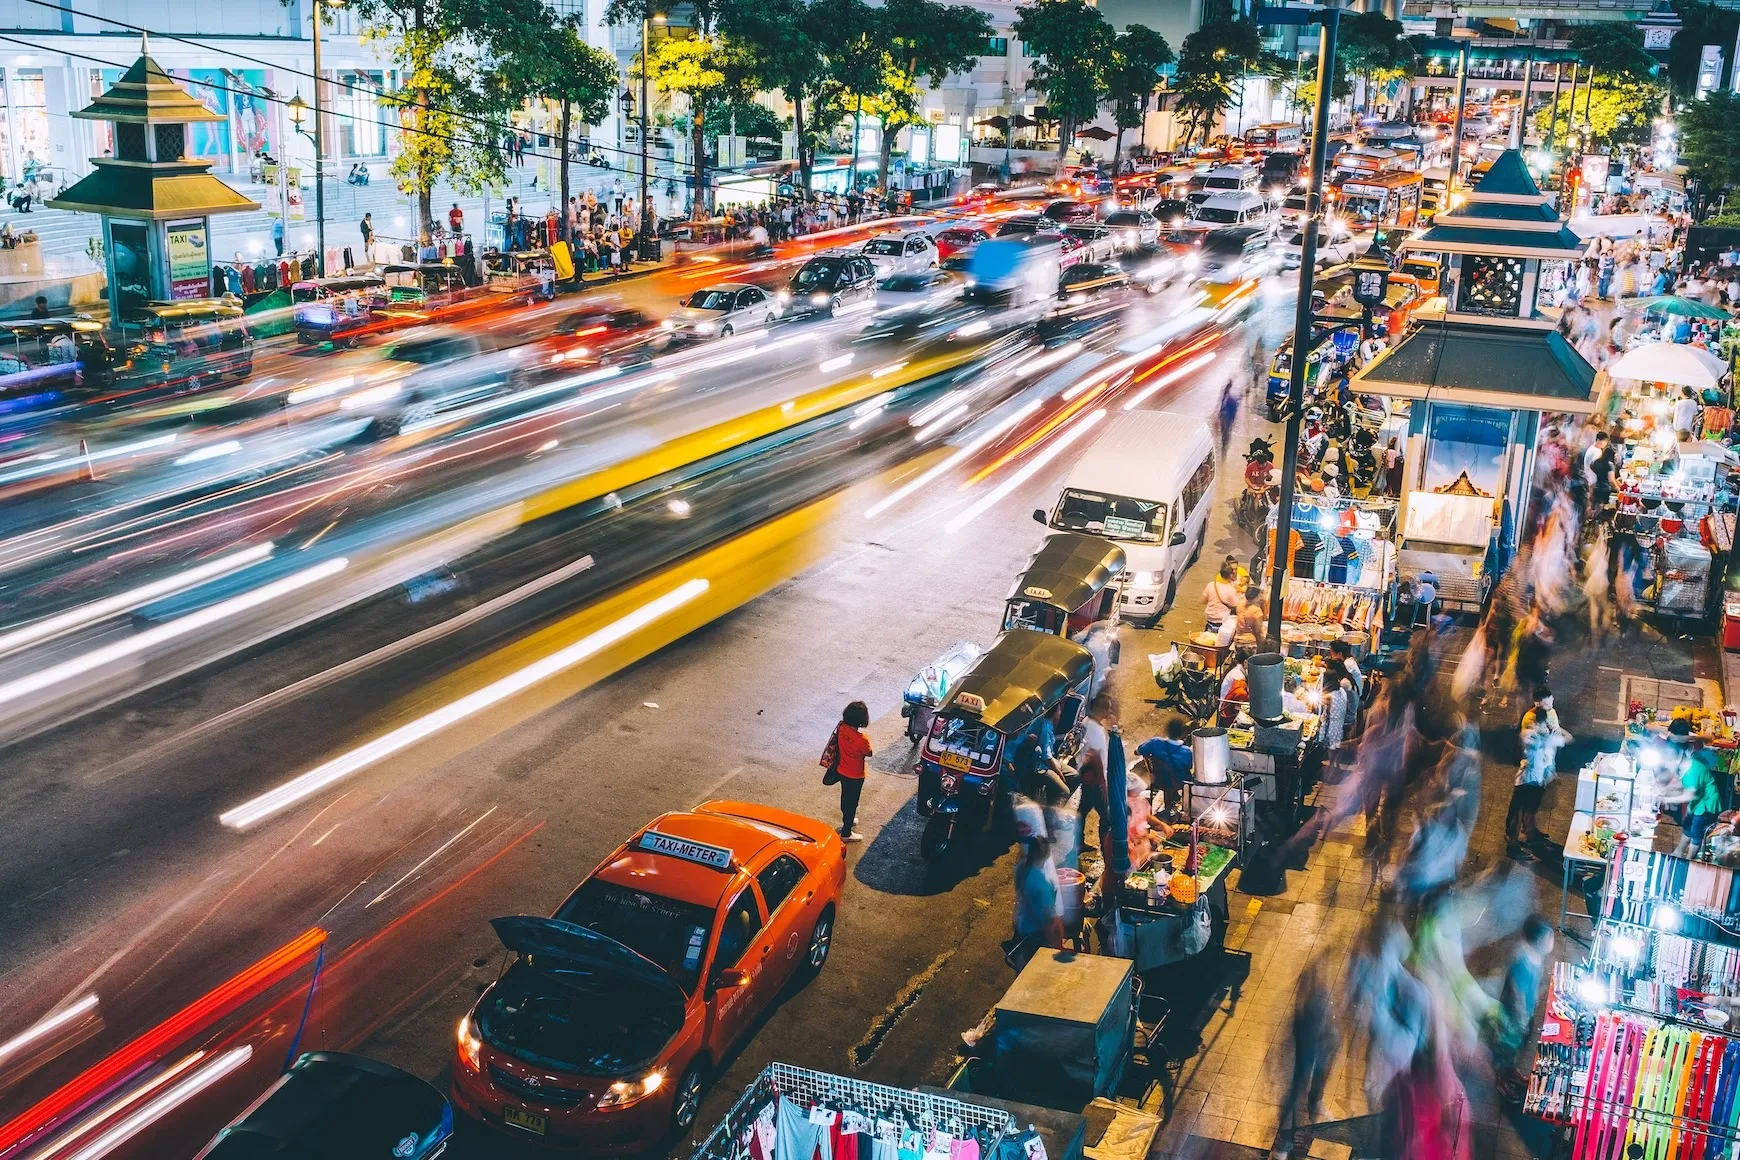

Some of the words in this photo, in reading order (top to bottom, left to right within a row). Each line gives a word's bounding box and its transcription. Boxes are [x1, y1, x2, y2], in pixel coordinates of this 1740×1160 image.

[170, 234, 187, 244] TAXI
[1030, 588, 1045, 596] TAXI
[960, 694, 979, 707] TAXI
[955, 755, 969, 766] 573
[653, 837, 717, 862] TAXI-METER
